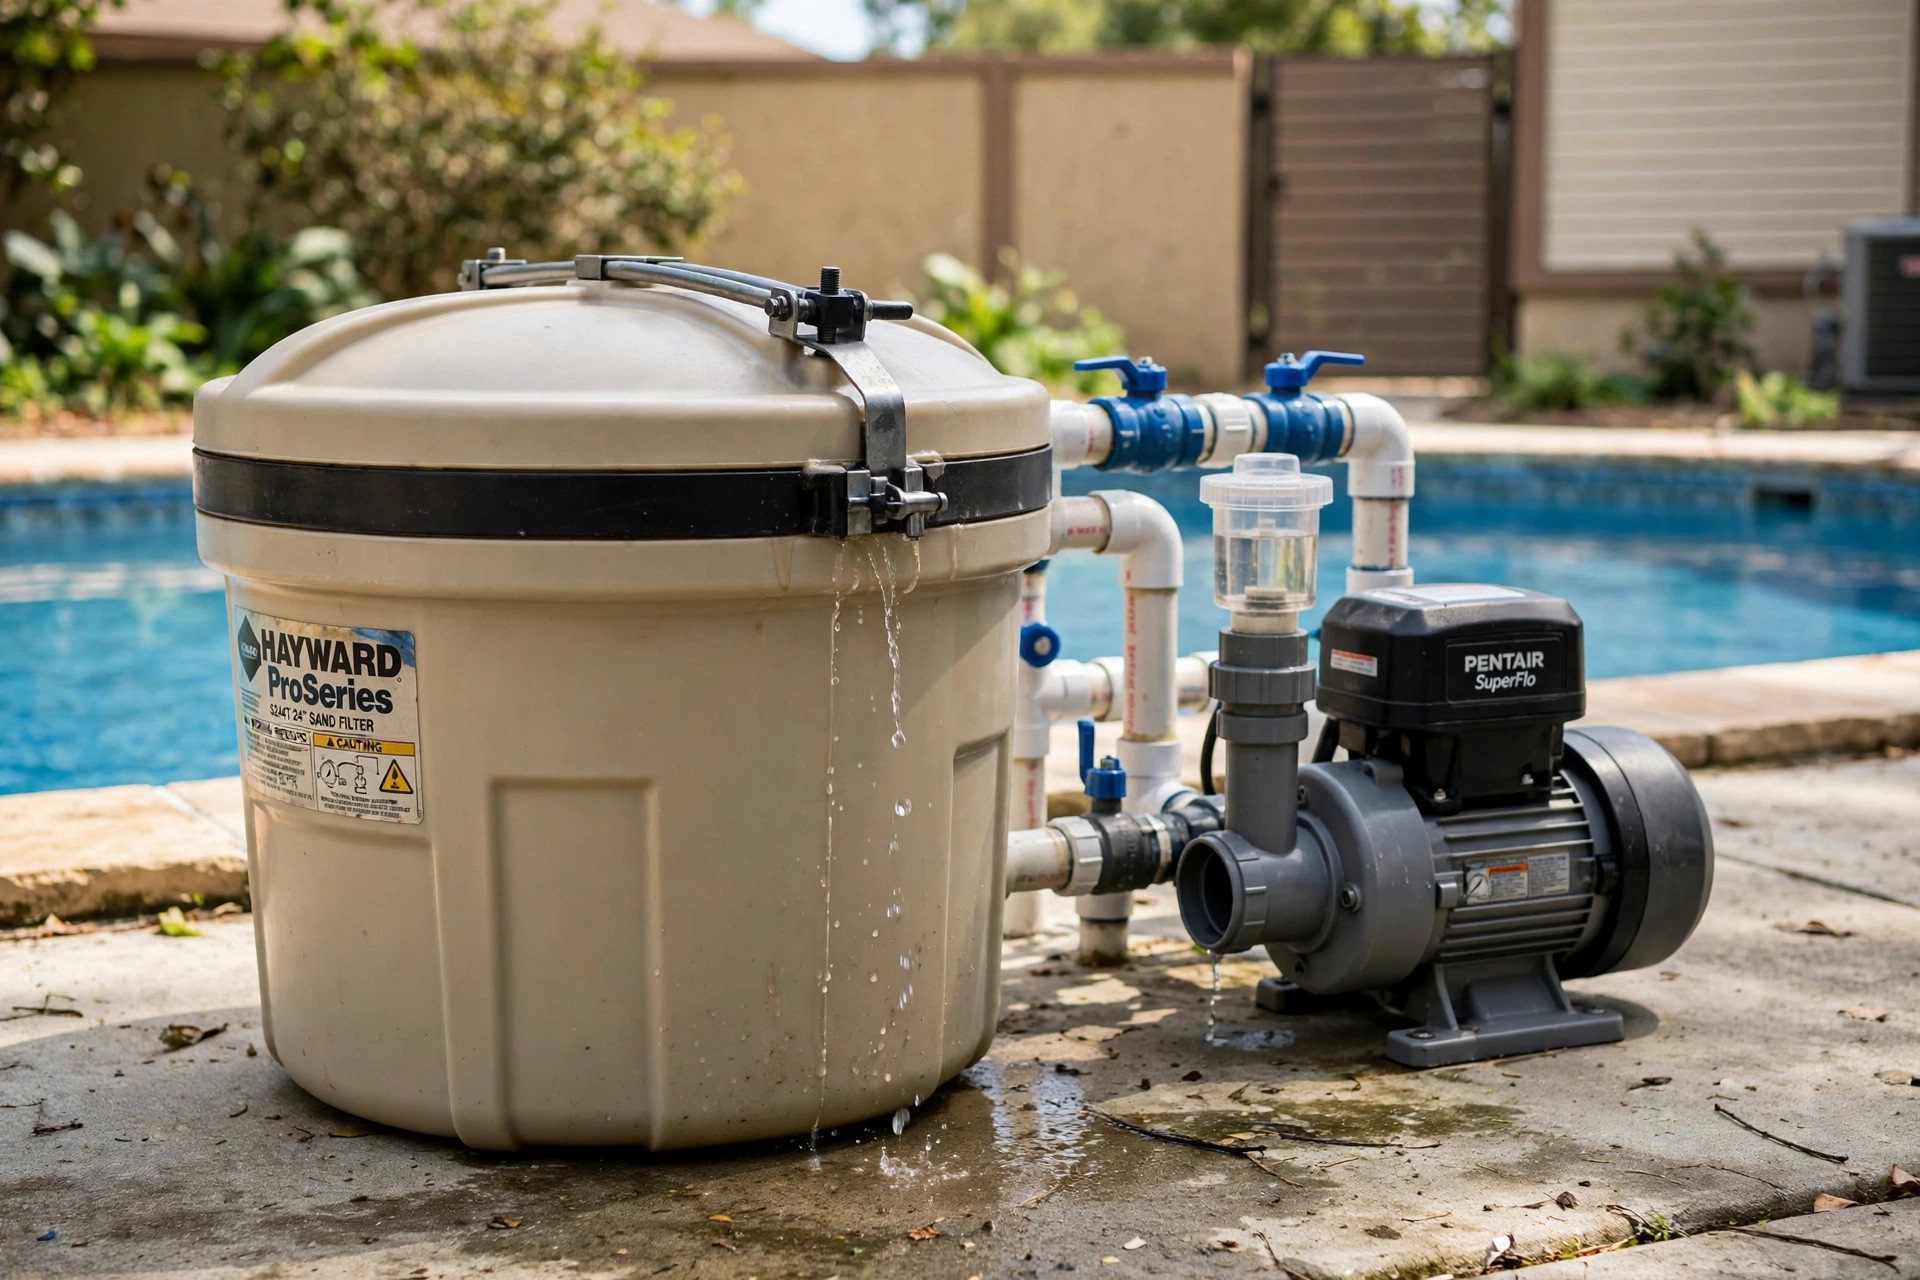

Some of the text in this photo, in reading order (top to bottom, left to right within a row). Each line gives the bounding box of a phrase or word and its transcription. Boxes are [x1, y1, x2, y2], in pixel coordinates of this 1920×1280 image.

[261, 629, 402, 678] HAYWARD
[1464, 651, 1545, 673] PENTAIR
[268, 665, 394, 715] ProSeries
[1474, 671, 1537, 693] SuperFlo
[309, 712, 336, 728] SAND
[339, 716, 375, 732] FILTER
